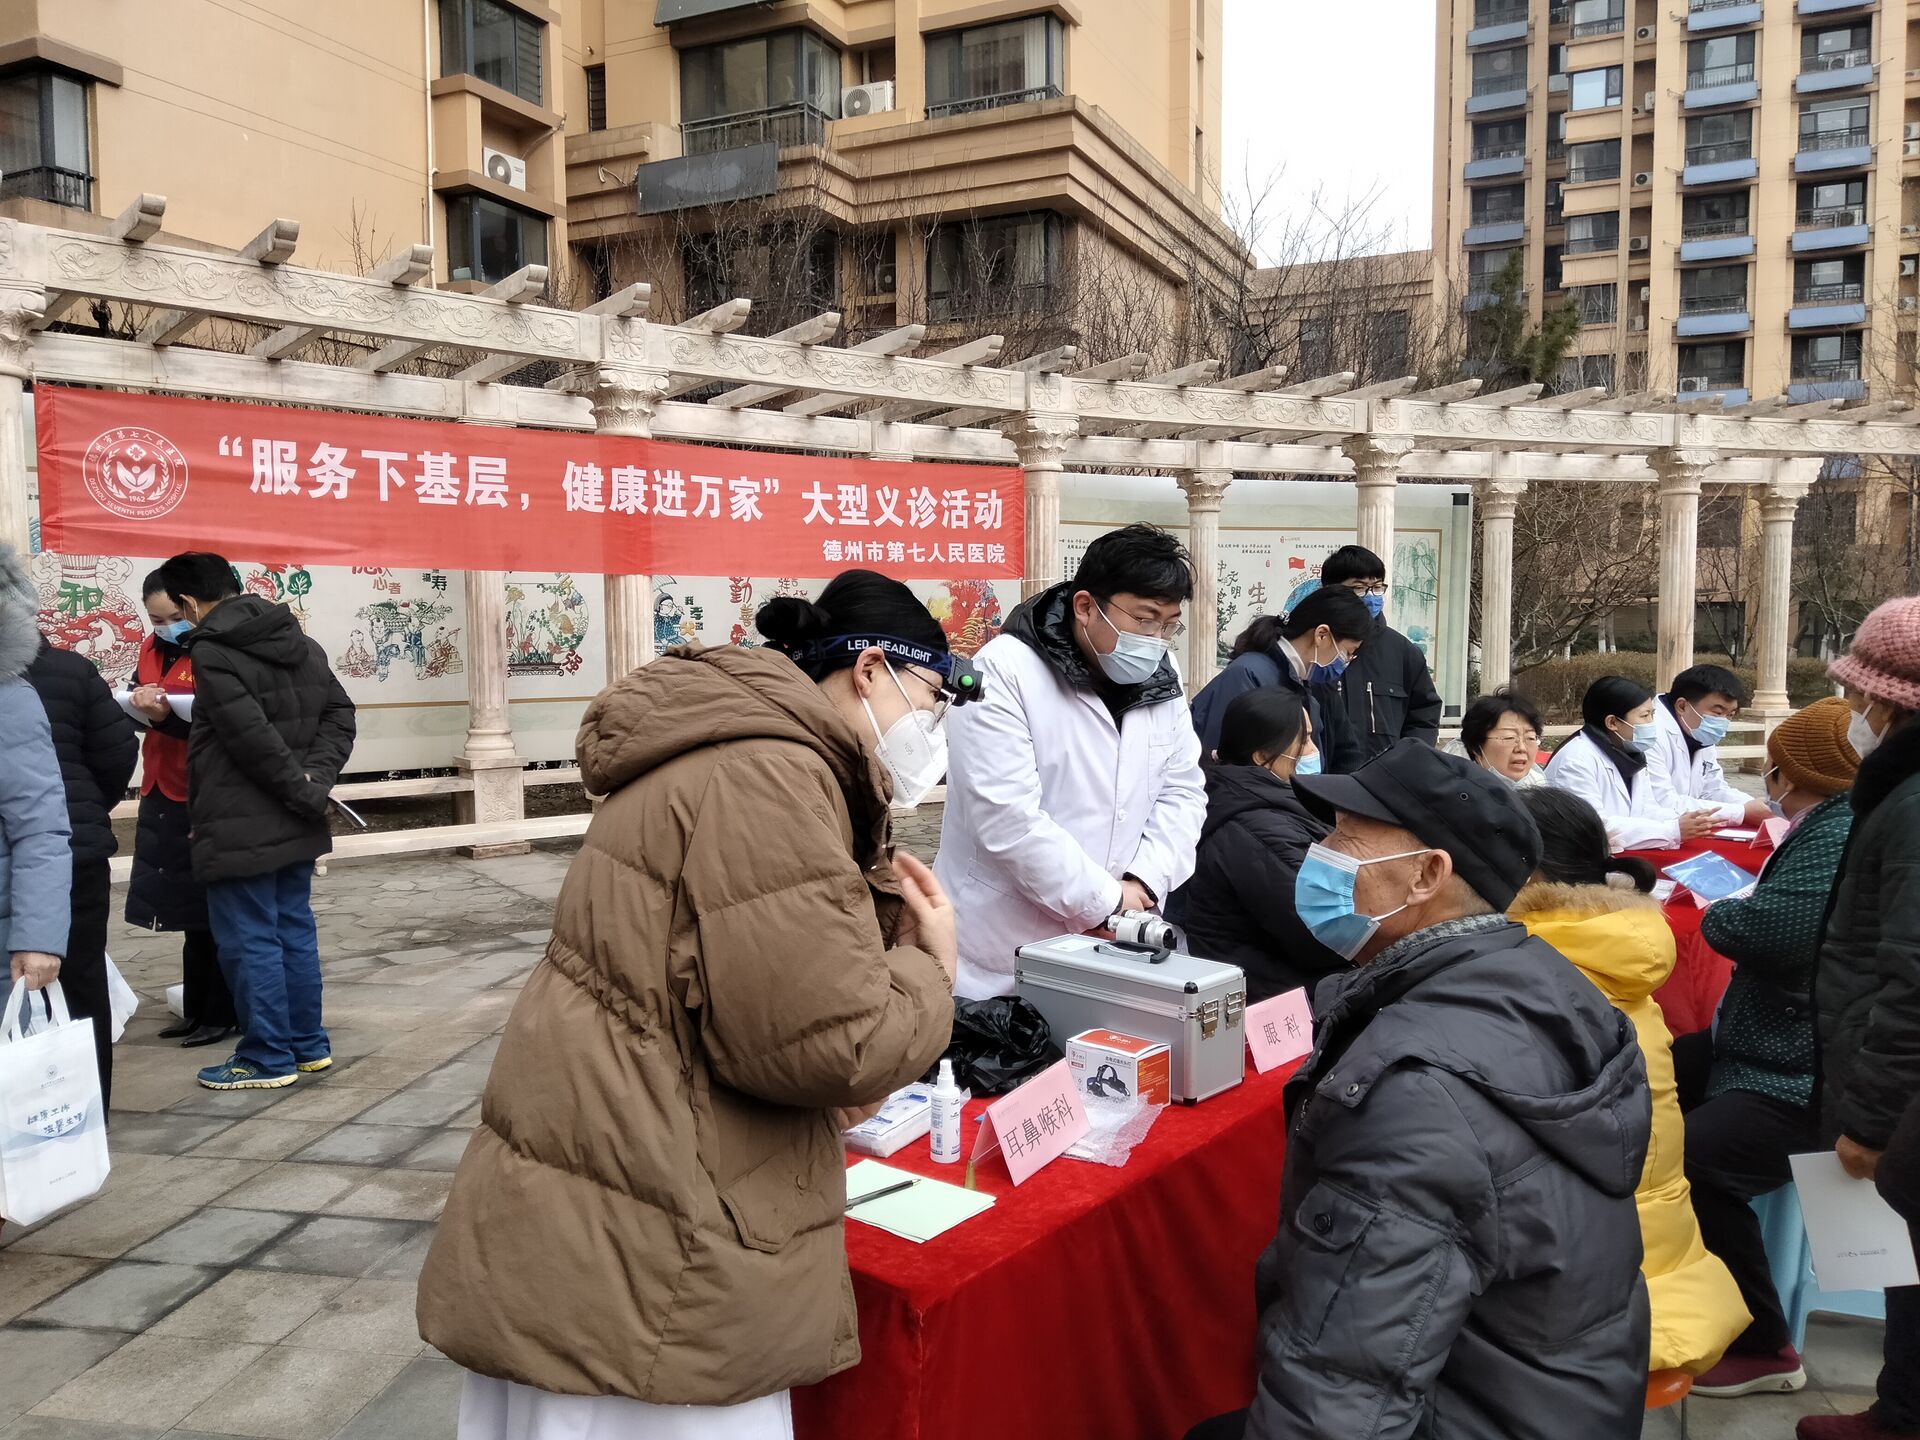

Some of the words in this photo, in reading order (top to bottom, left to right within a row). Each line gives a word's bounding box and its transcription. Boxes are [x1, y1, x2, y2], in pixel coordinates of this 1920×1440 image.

[89, 477, 107, 501] DEZHOU
[106, 500, 135, 515] SEVENTH
[165, 483, 183, 507] HOSPITAL
[128, 495, 146, 503] 1962
[801, 481, 1003, 530] 大型义诊活动
[822, 539, 1006, 564] 德州市第七人民医院
[57, 580, 105, 619] 和
[847, 639, 870, 651] LED
[877, 640, 932, 663] HEADLIGHT
[1263, 1013, 1302, 1046] 眼科
[1002, 1093, 1075, 1159] 耳鼻喉科
